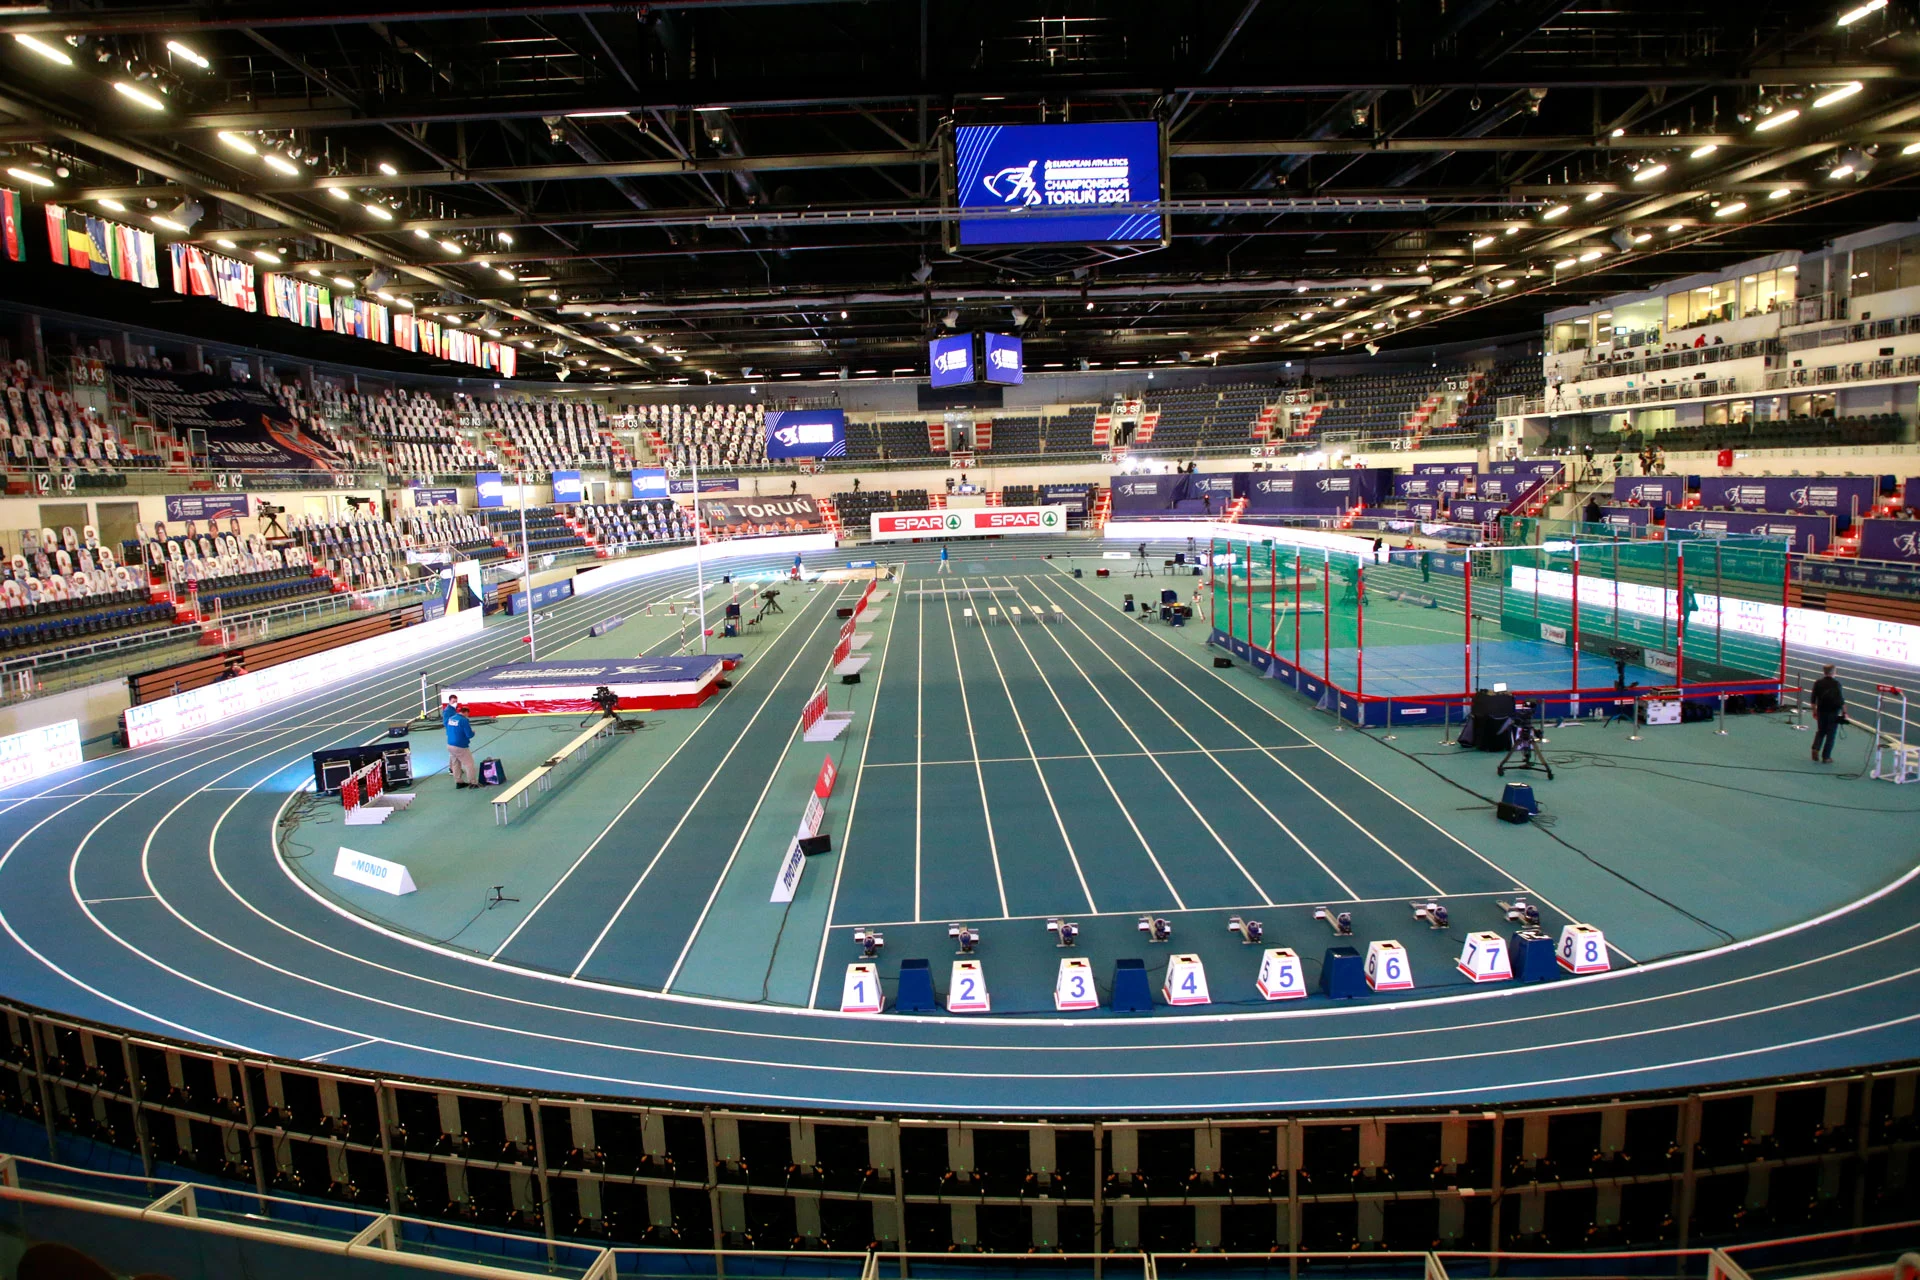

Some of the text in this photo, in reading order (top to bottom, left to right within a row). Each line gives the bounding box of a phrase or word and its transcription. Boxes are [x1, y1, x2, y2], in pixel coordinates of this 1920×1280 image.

[1052, 158, 1128, 168] EUROPEAN ATHLETICS
[1044, 177, 1129, 190] CHAMPIONSHIPS
[1098, 189, 1130, 203] 2021
[1447, 382, 1456, 390] T3
[1285, 395, 1295, 403] S3
[224, 441, 280, 454] MARCA
[1250, 446, 1275, 455] S2 T2
[1390, 441, 1400, 449] T2
[814, 464, 825, 472] P2
[61, 474, 76, 490] J2
[217, 475, 227, 488] J2
[231, 474, 244, 488] K2
[335, 475, 355, 485] K2 L2
[733, 498, 812, 518] TORUŃ
[894, 518, 943, 530] SPAR
[990, 514, 1040, 526] SPAR
[356, 860, 387, 878] MONDO
[1467, 943, 1477, 965] 7
[1563, 936, 1573, 958] 8
[1585, 940, 1598, 962] 8
[1368, 953, 1376, 974] 6
[1486, 948, 1500, 970] 7
[1263, 961, 1270, 982] 5
[1279, 965, 1294, 987] 5
[1386, 957, 1400, 979] 6
[854, 981, 864, 1002] 1
[960, 978, 975, 1000] 2
[1071, 976, 1085, 998] 3
[1181, 972, 1197, 994] 4
